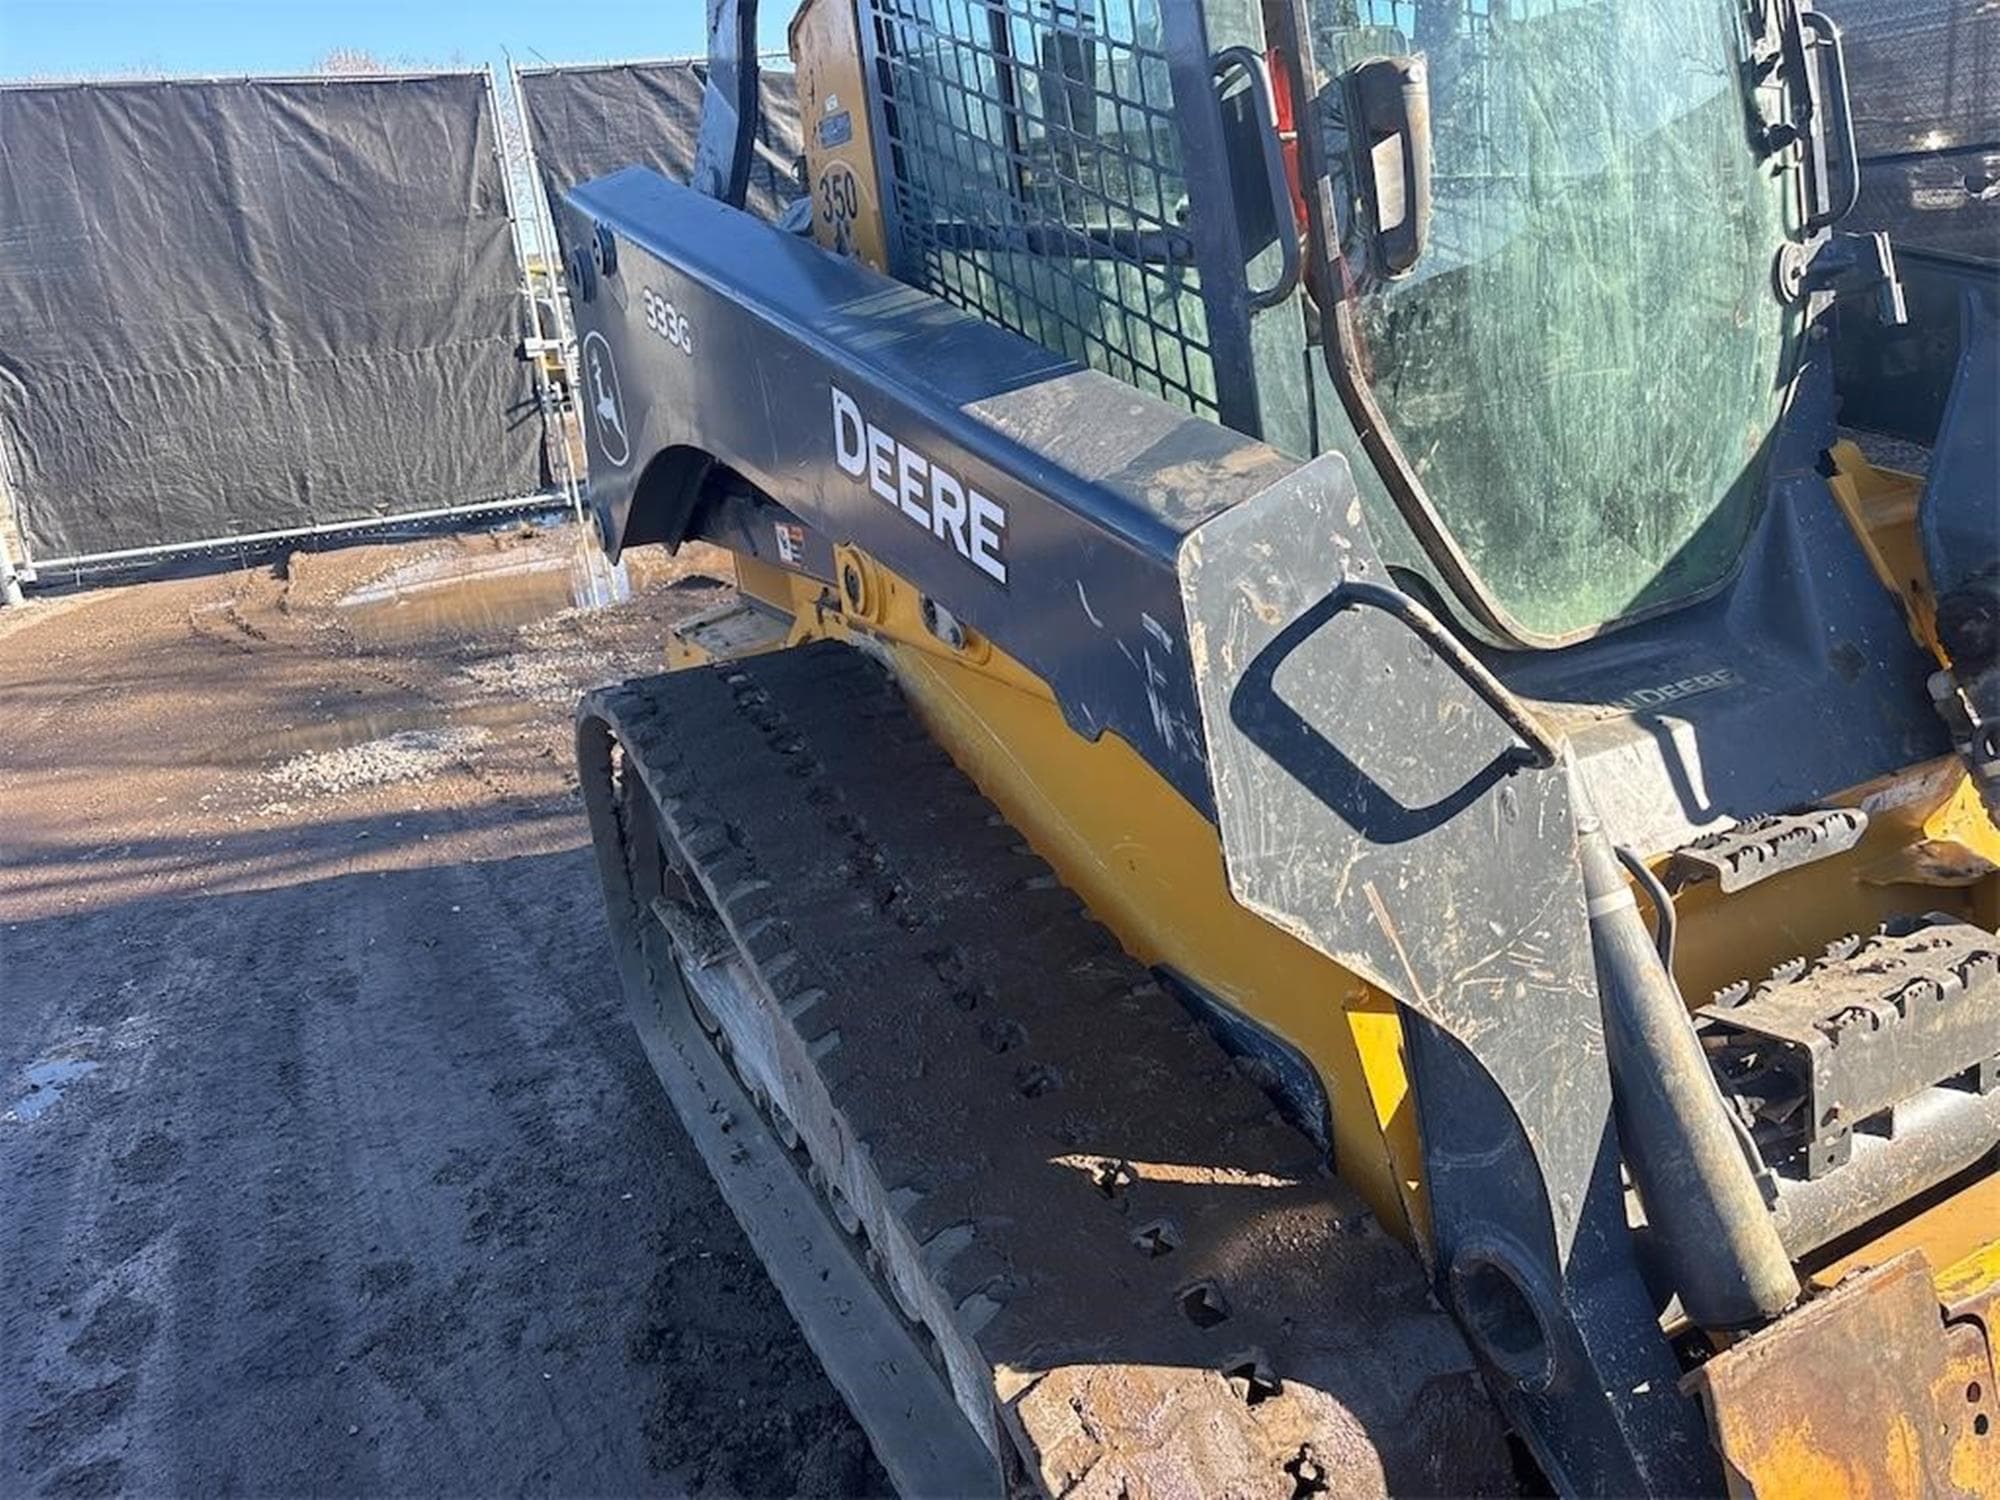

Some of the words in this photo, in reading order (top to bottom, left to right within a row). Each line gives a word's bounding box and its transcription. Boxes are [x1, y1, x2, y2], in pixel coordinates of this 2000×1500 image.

[820, 171, 857, 223] 350
[643, 288, 692, 355] 333G
[831, 386, 1007, 584] DEERE
